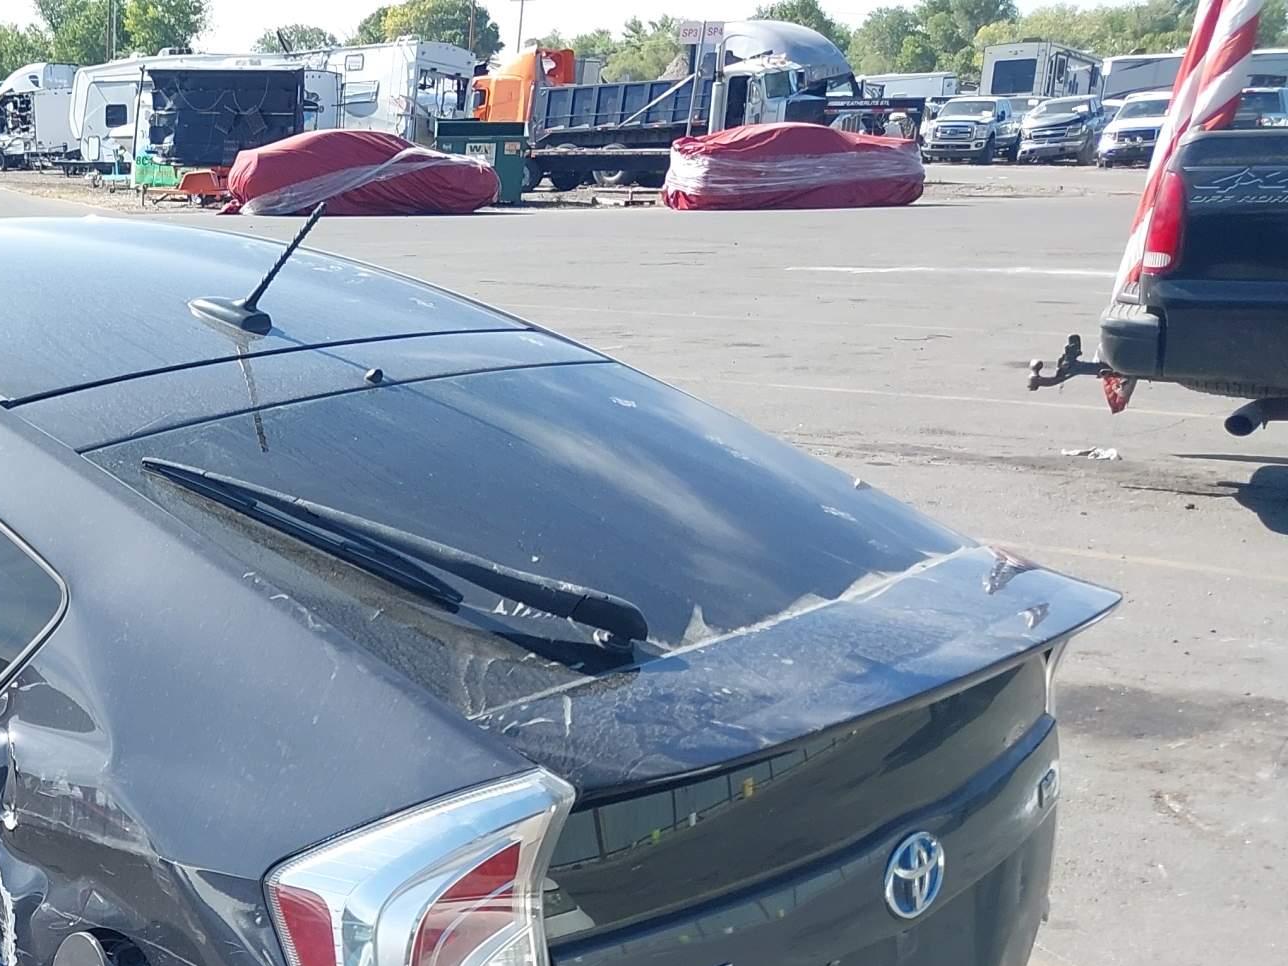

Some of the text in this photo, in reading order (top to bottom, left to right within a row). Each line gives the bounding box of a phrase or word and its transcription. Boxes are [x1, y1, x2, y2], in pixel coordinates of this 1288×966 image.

[681, 28, 698, 38] SP3
[707, 26, 724, 37] SP4
[1237, 194, 1288, 203] ROA
